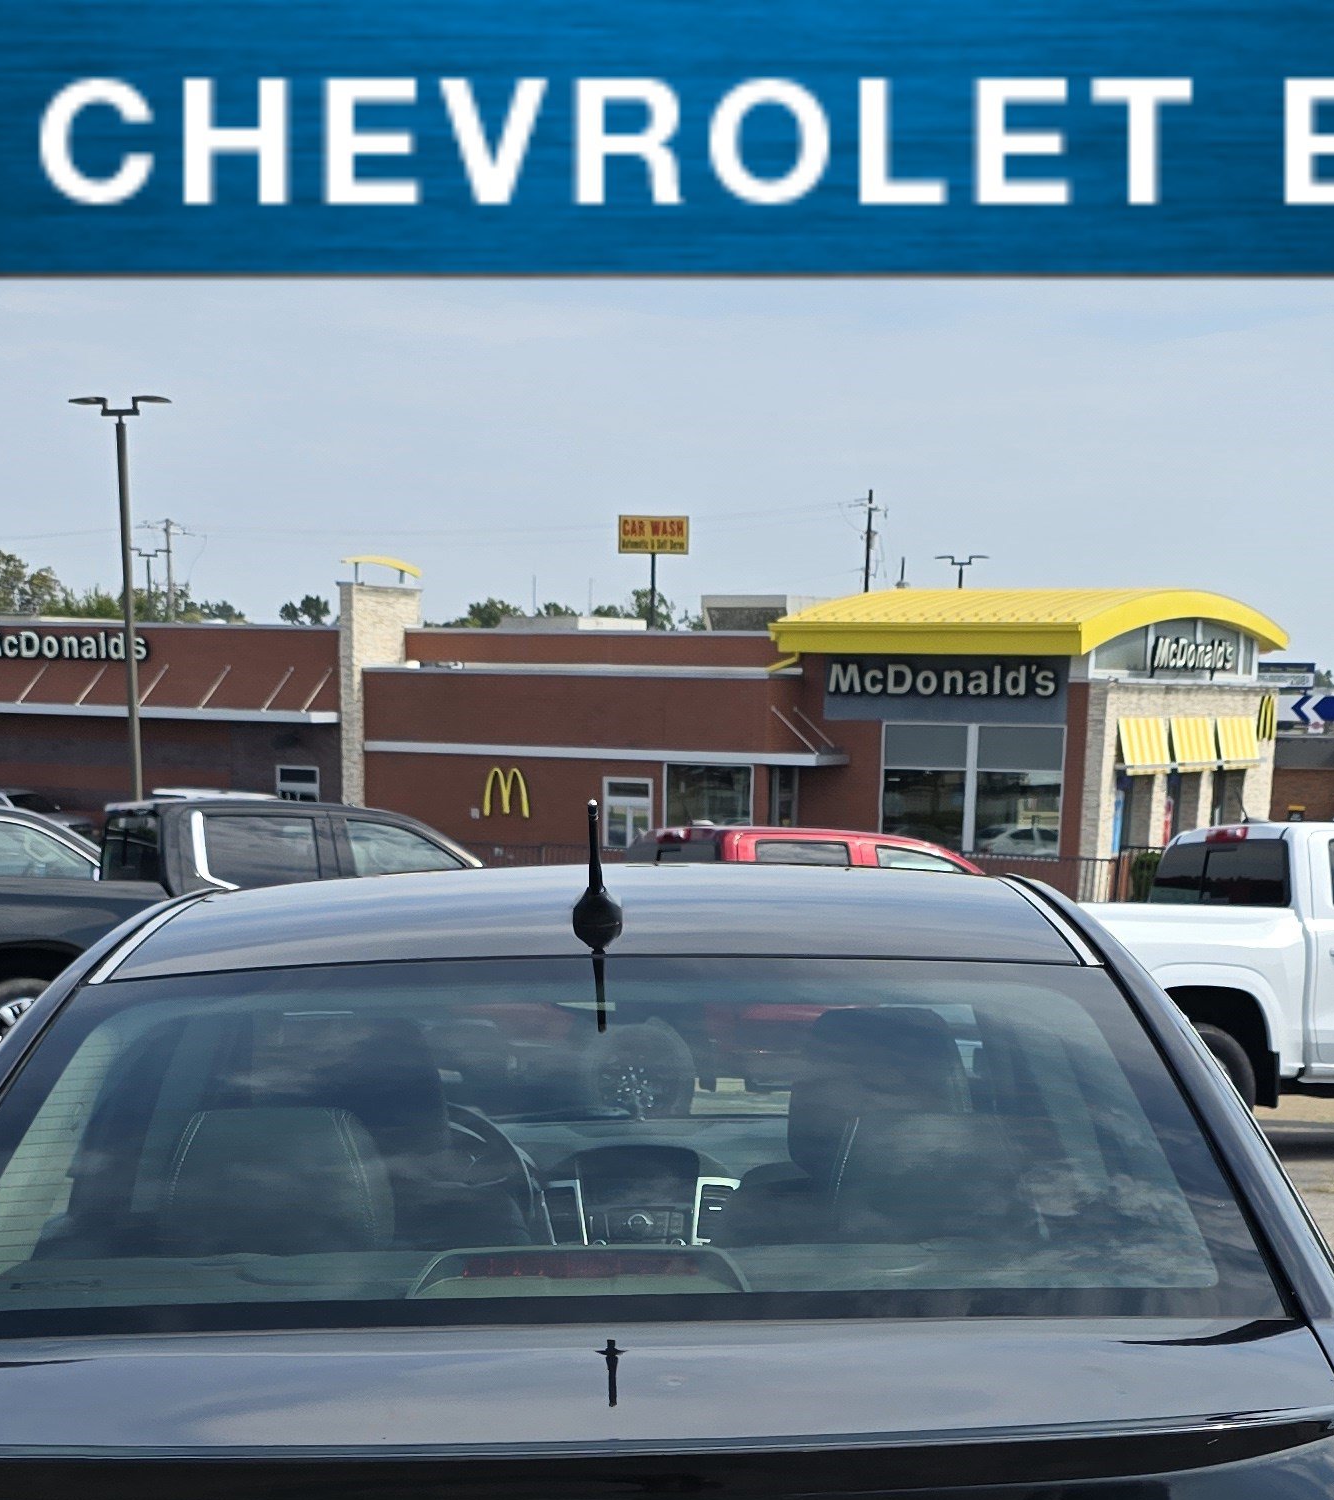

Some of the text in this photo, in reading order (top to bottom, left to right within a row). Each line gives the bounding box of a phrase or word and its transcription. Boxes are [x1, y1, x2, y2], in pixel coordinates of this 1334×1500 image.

[623, 520, 684, 537] CAR WASH
[1154, 636, 1234, 670] McDonald's
[828, 663, 1056, 696] McDonald's
